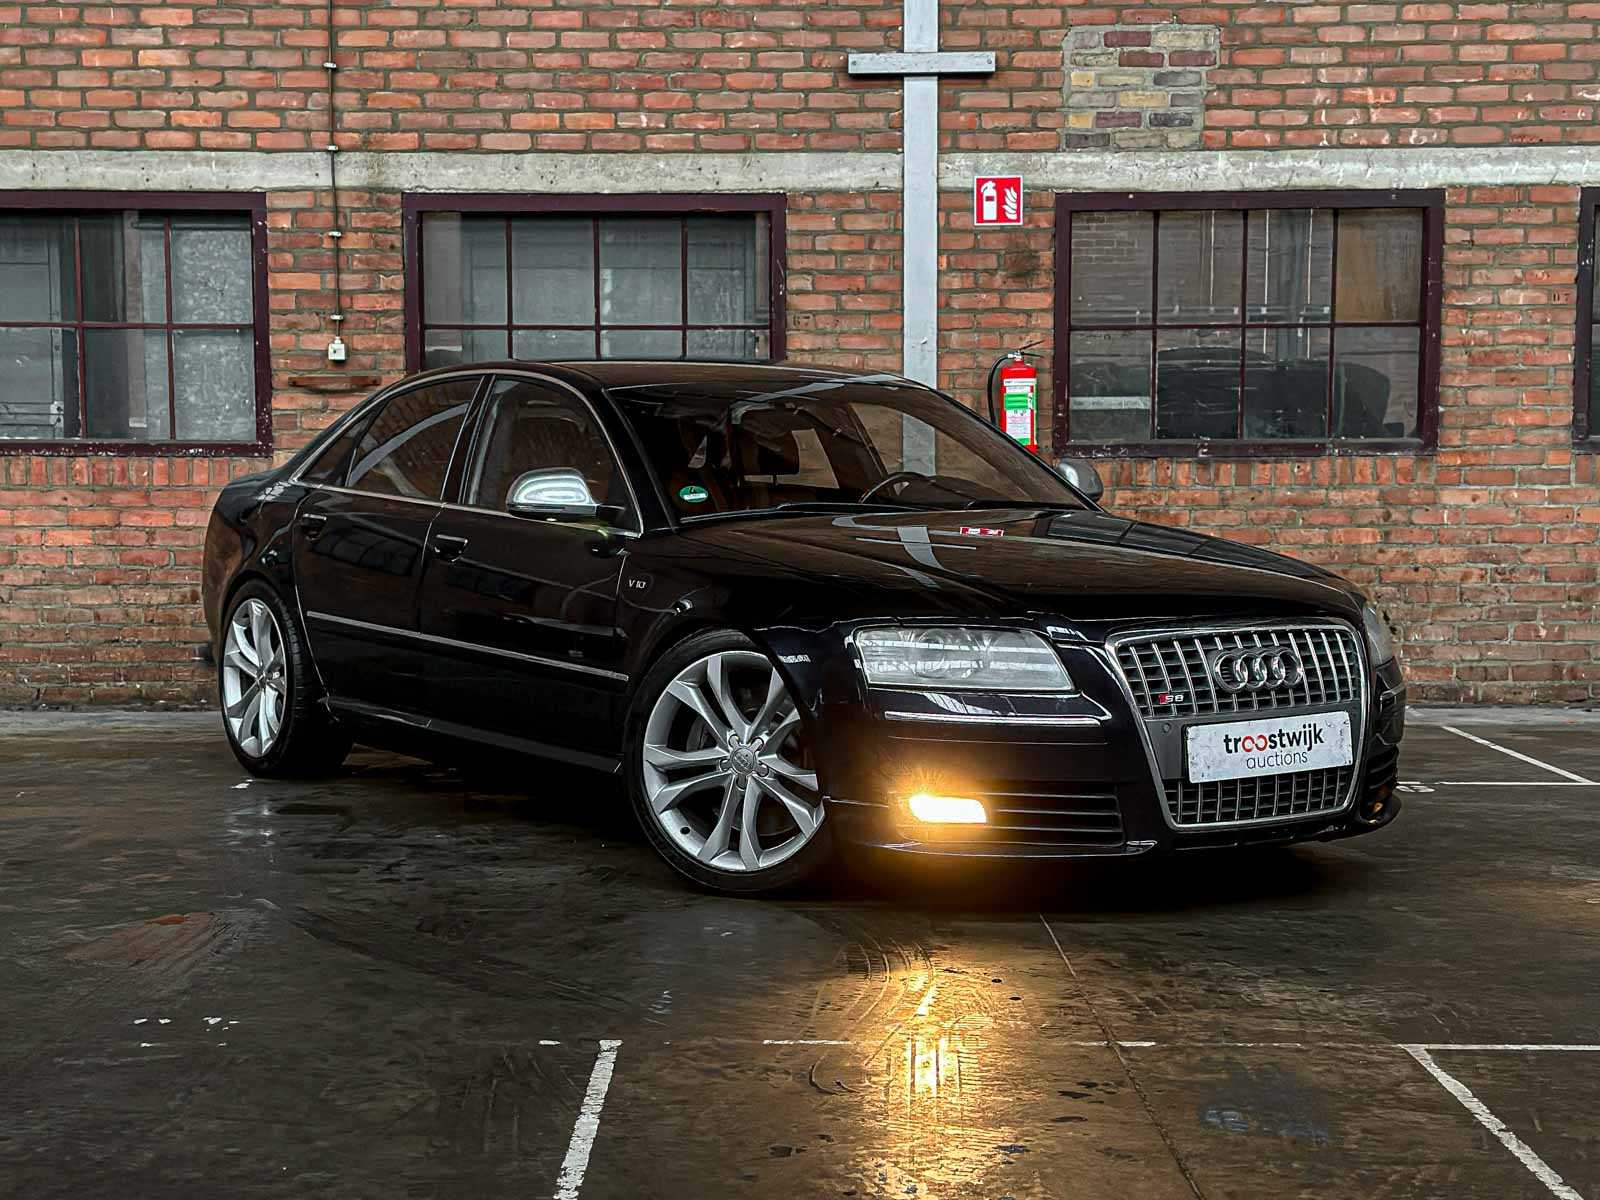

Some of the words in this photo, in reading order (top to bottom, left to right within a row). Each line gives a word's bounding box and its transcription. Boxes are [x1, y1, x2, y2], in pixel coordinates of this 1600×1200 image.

[1165, 694, 1184, 703] S8
[1223, 723, 1324, 753] troostwijk
[1246, 751, 1308, 769] auctions
